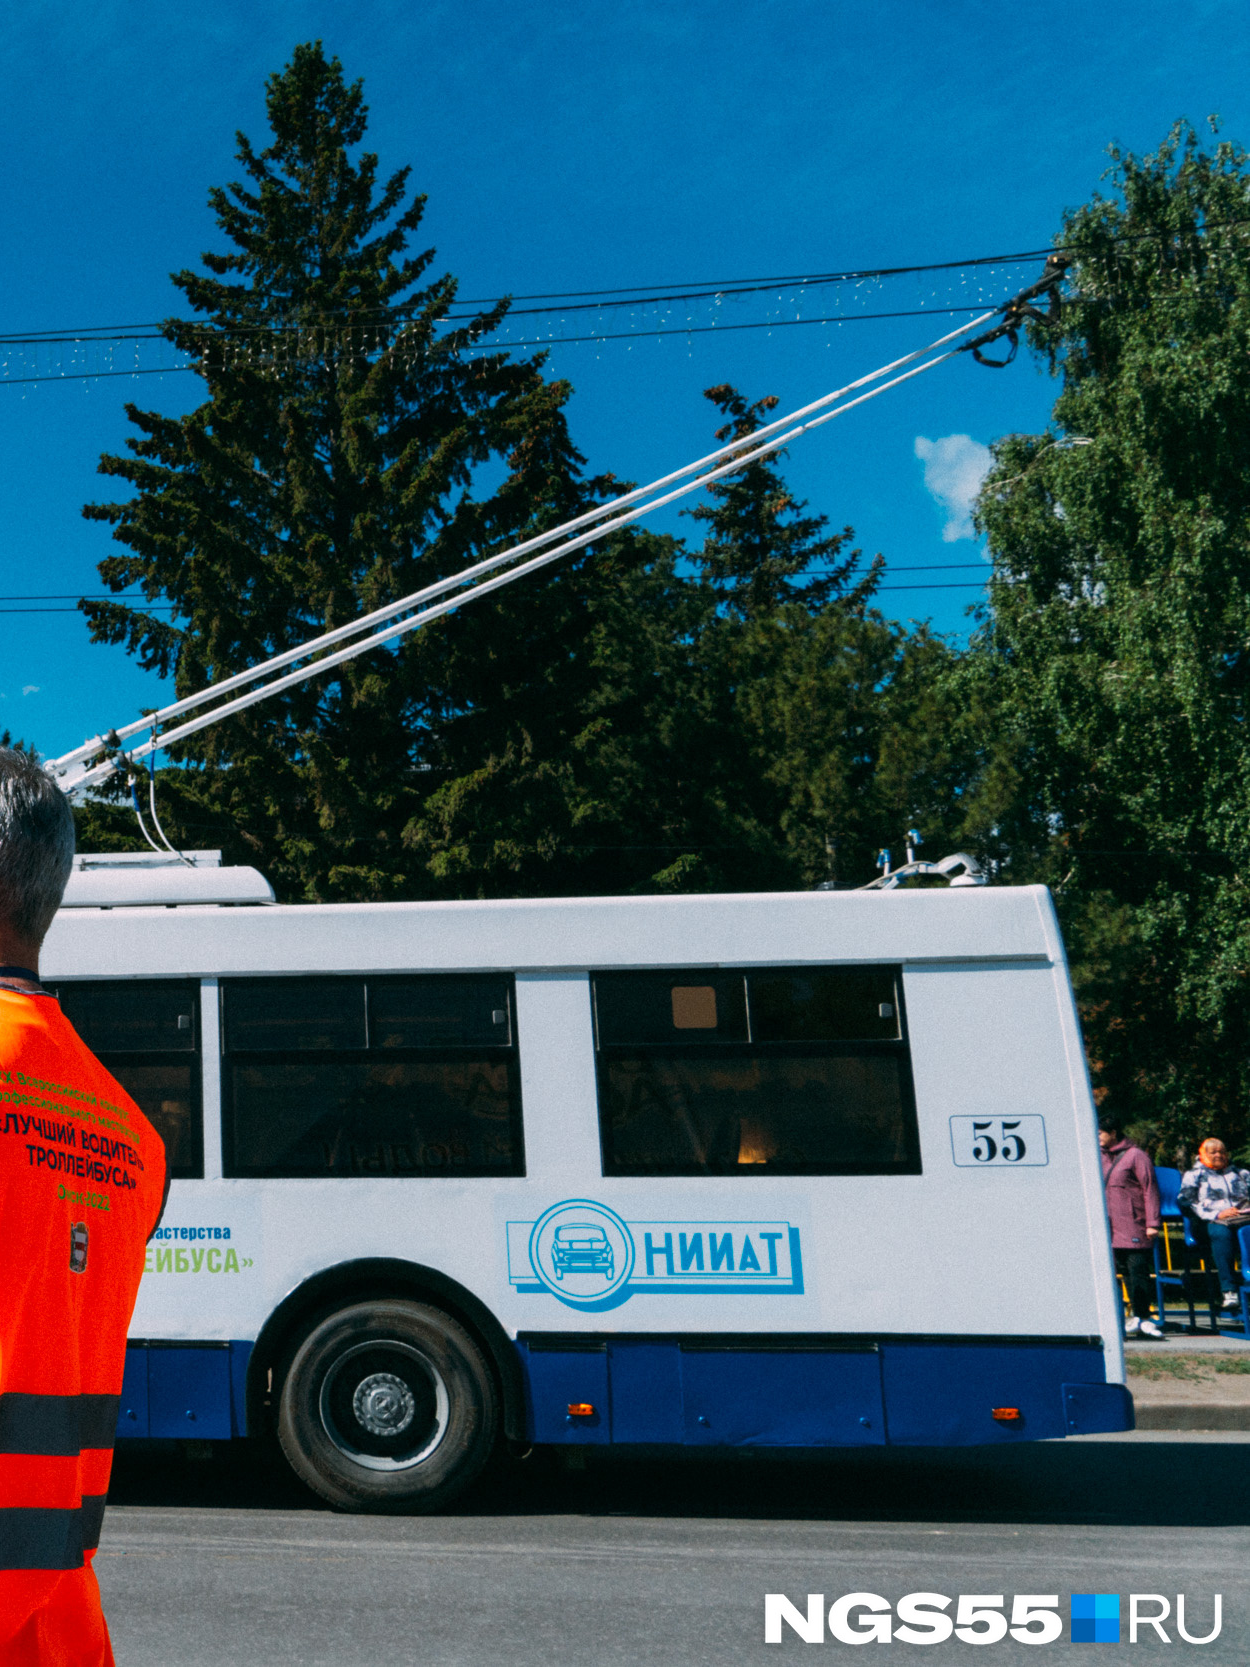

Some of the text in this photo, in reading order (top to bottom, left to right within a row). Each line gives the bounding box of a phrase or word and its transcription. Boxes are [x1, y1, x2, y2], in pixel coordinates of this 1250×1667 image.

[16, 1071, 98, 1107] Всероссийский
[972, 1120, 1027, 1162] 55
[25, 1144, 137, 1190] ТРОЛЛЕЙБУСА»
[152, 1227, 232, 1242] астерства
[644, 1231, 783, 1276] НИИАТ
